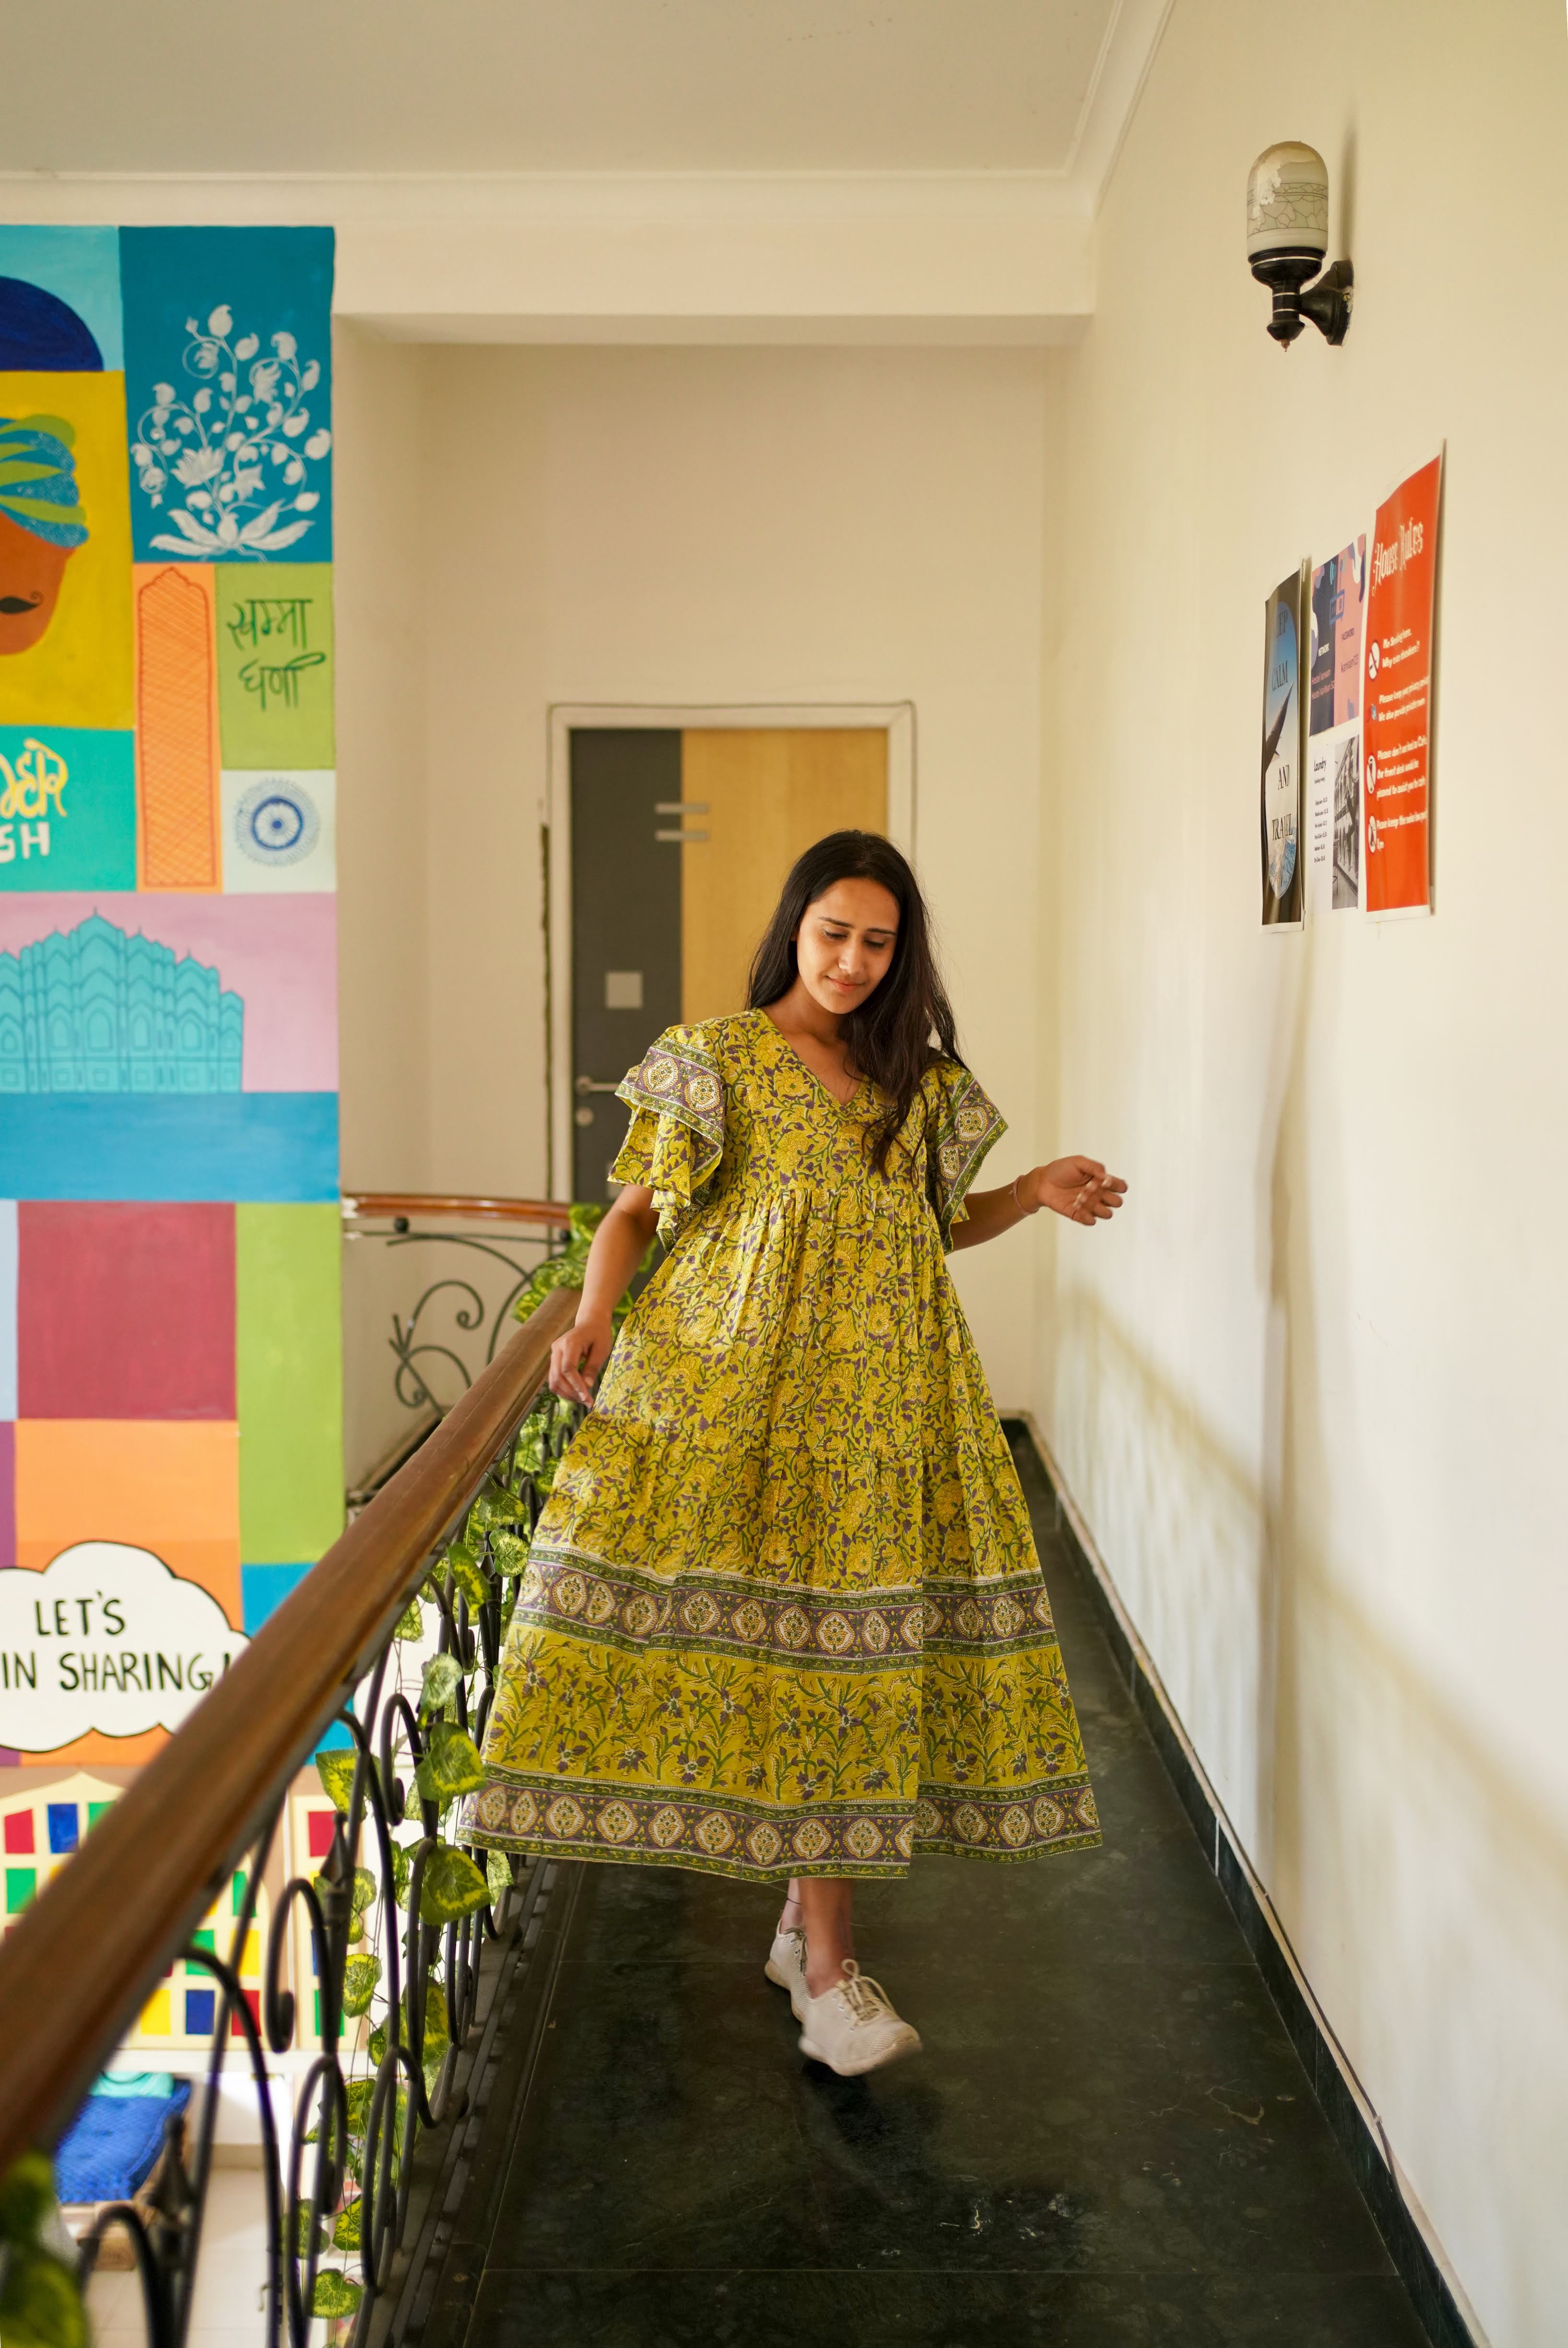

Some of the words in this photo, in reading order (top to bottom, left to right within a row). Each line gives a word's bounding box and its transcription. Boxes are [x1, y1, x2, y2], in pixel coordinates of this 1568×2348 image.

[1371, 542, 1398, 597] House
[1399, 516, 1424, 571] Rules
[1318, 643, 1330, 657] NETWORK
[1272, 660, 1289, 691] CALM
[1314, 756, 1327, 771] Laundry
[1377, 750, 1391, 761] Please
[1278, 764, 1290, 790] AND
[1272, 813, 1293, 841] TRAVEL
[35, 1589, 126, 1636] LET'S
